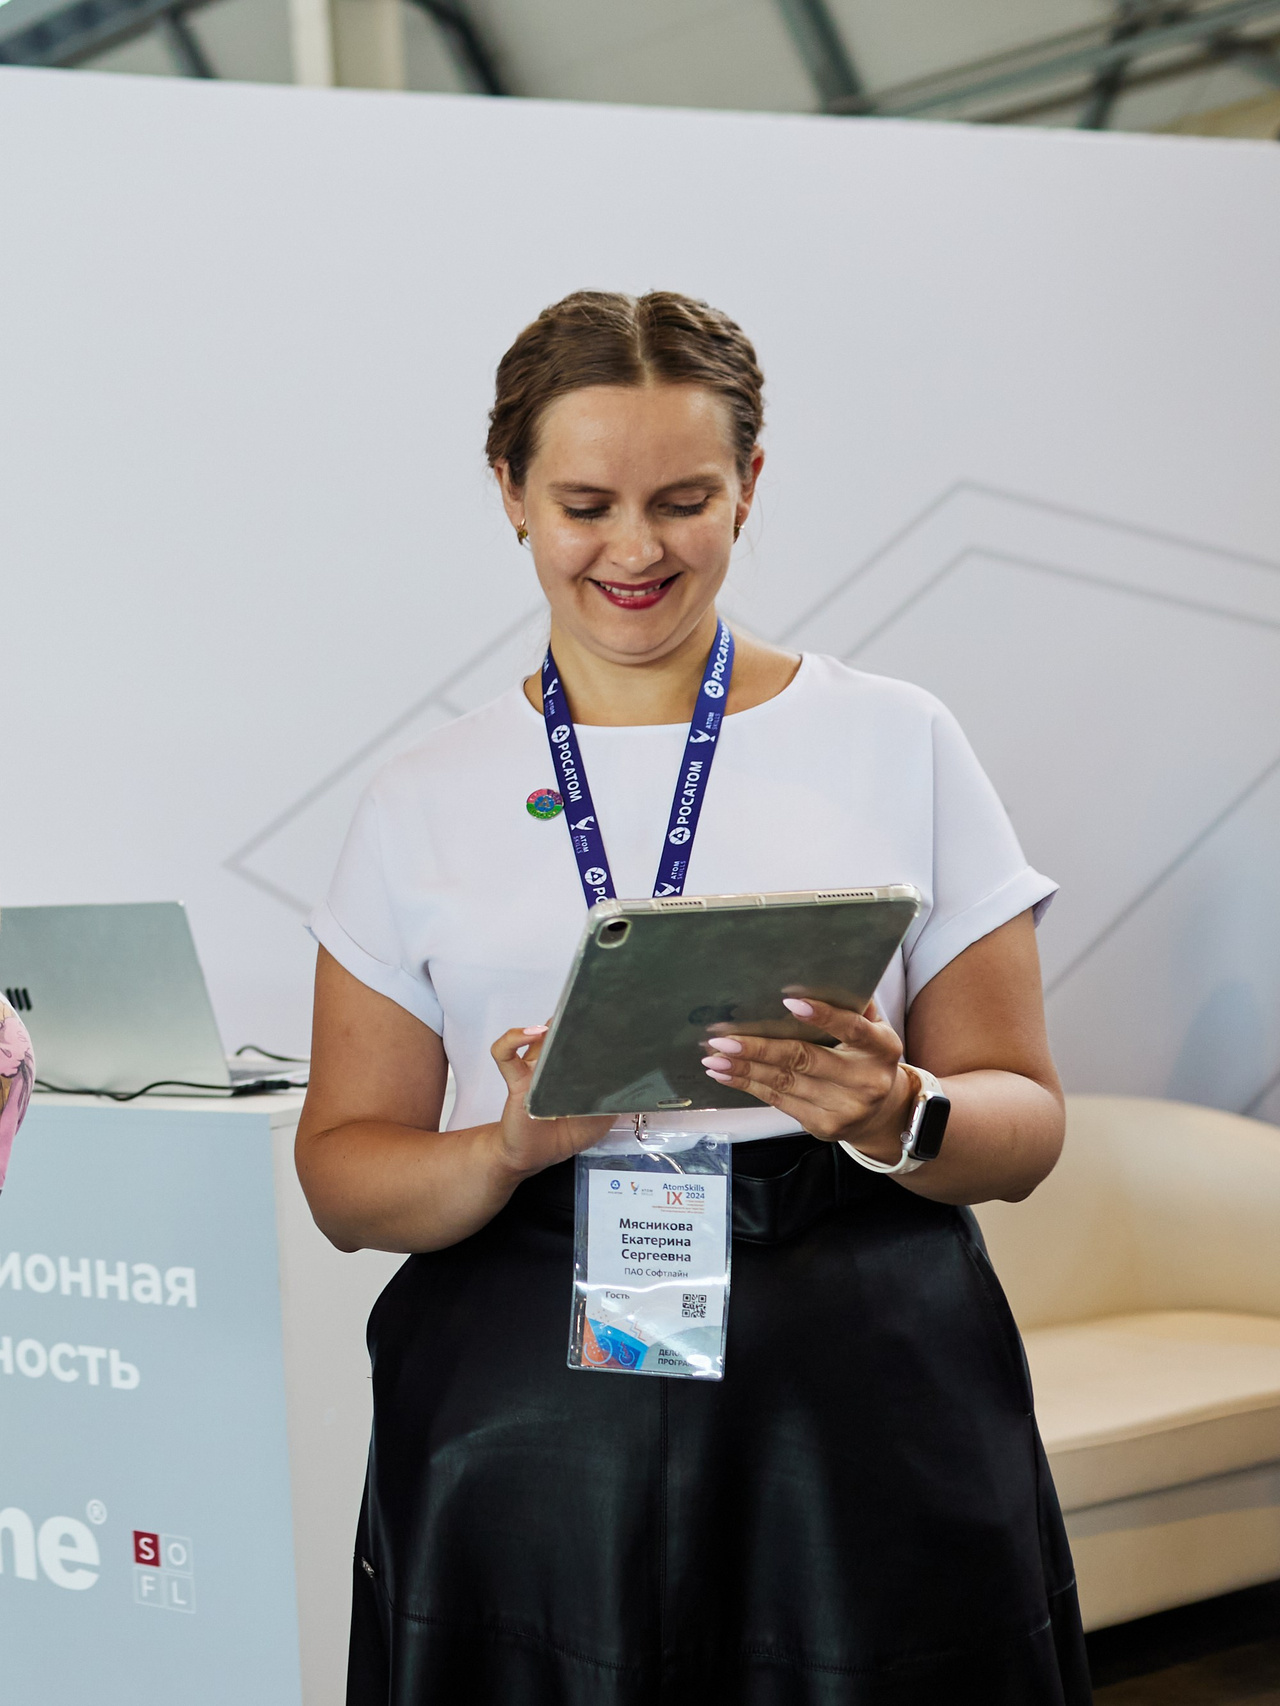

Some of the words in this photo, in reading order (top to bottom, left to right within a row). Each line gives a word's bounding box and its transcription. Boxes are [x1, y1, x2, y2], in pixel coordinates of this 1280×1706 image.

[558, 742, 583, 803] РОСАТОМ
[676, 760, 703, 825] РОСАТОМ
[662, 1183, 705, 1192] AtomSkills
[666, 1191, 683, 1206] IX
[619, 1218, 693, 1232] Мясникова
[621, 1234, 691, 1248] Екатерина
[621, 1249, 691, 1263] Сергеевна
[624, 1267, 644, 1276] ПАО
[646, 1268, 689, 1279] Софтлайн
[605, 1291, 630, 1300] Гость
[658, 1349, 681, 1357] ДЕЛО
[658, 1358, 690, 1367] ПРОГРА
